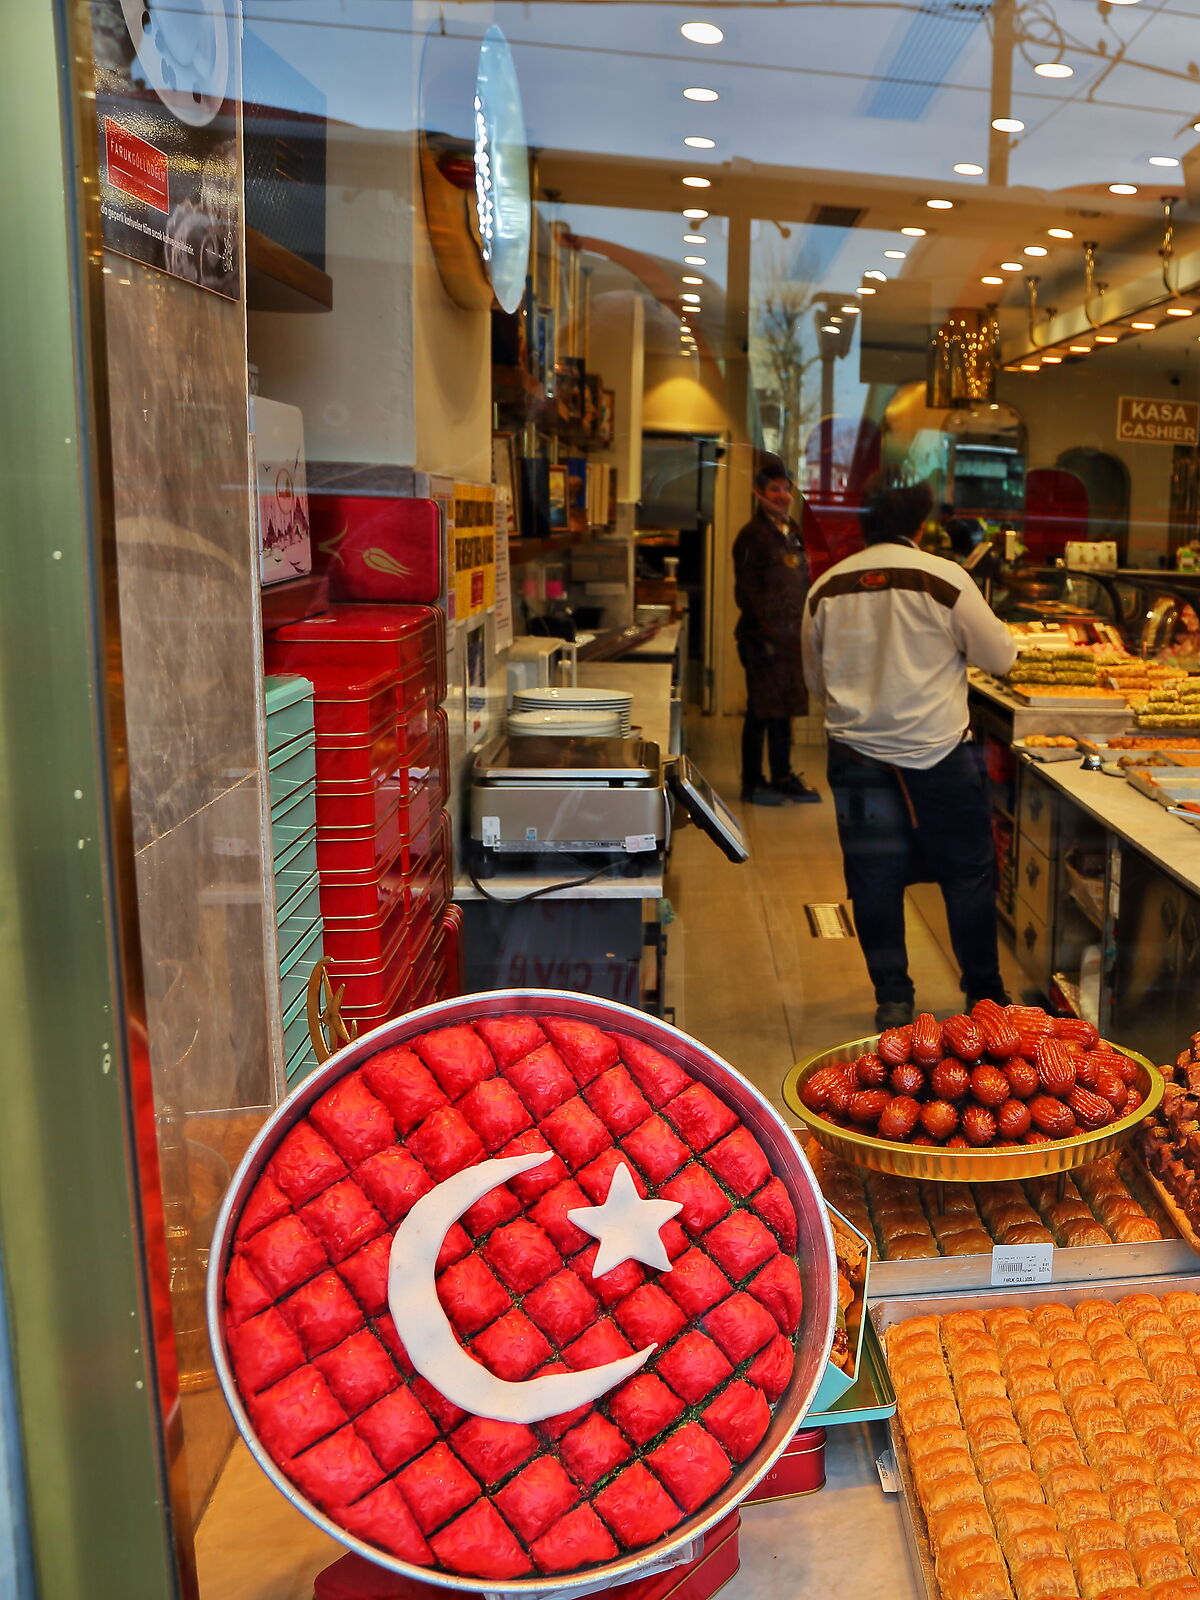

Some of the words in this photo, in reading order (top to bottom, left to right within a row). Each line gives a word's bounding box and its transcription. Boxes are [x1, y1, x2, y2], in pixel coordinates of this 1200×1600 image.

[143, 223, 152, 236] tüm
[1131, 401, 1187, 422] KASA
[1121, 421, 1197, 442] CASHIER
